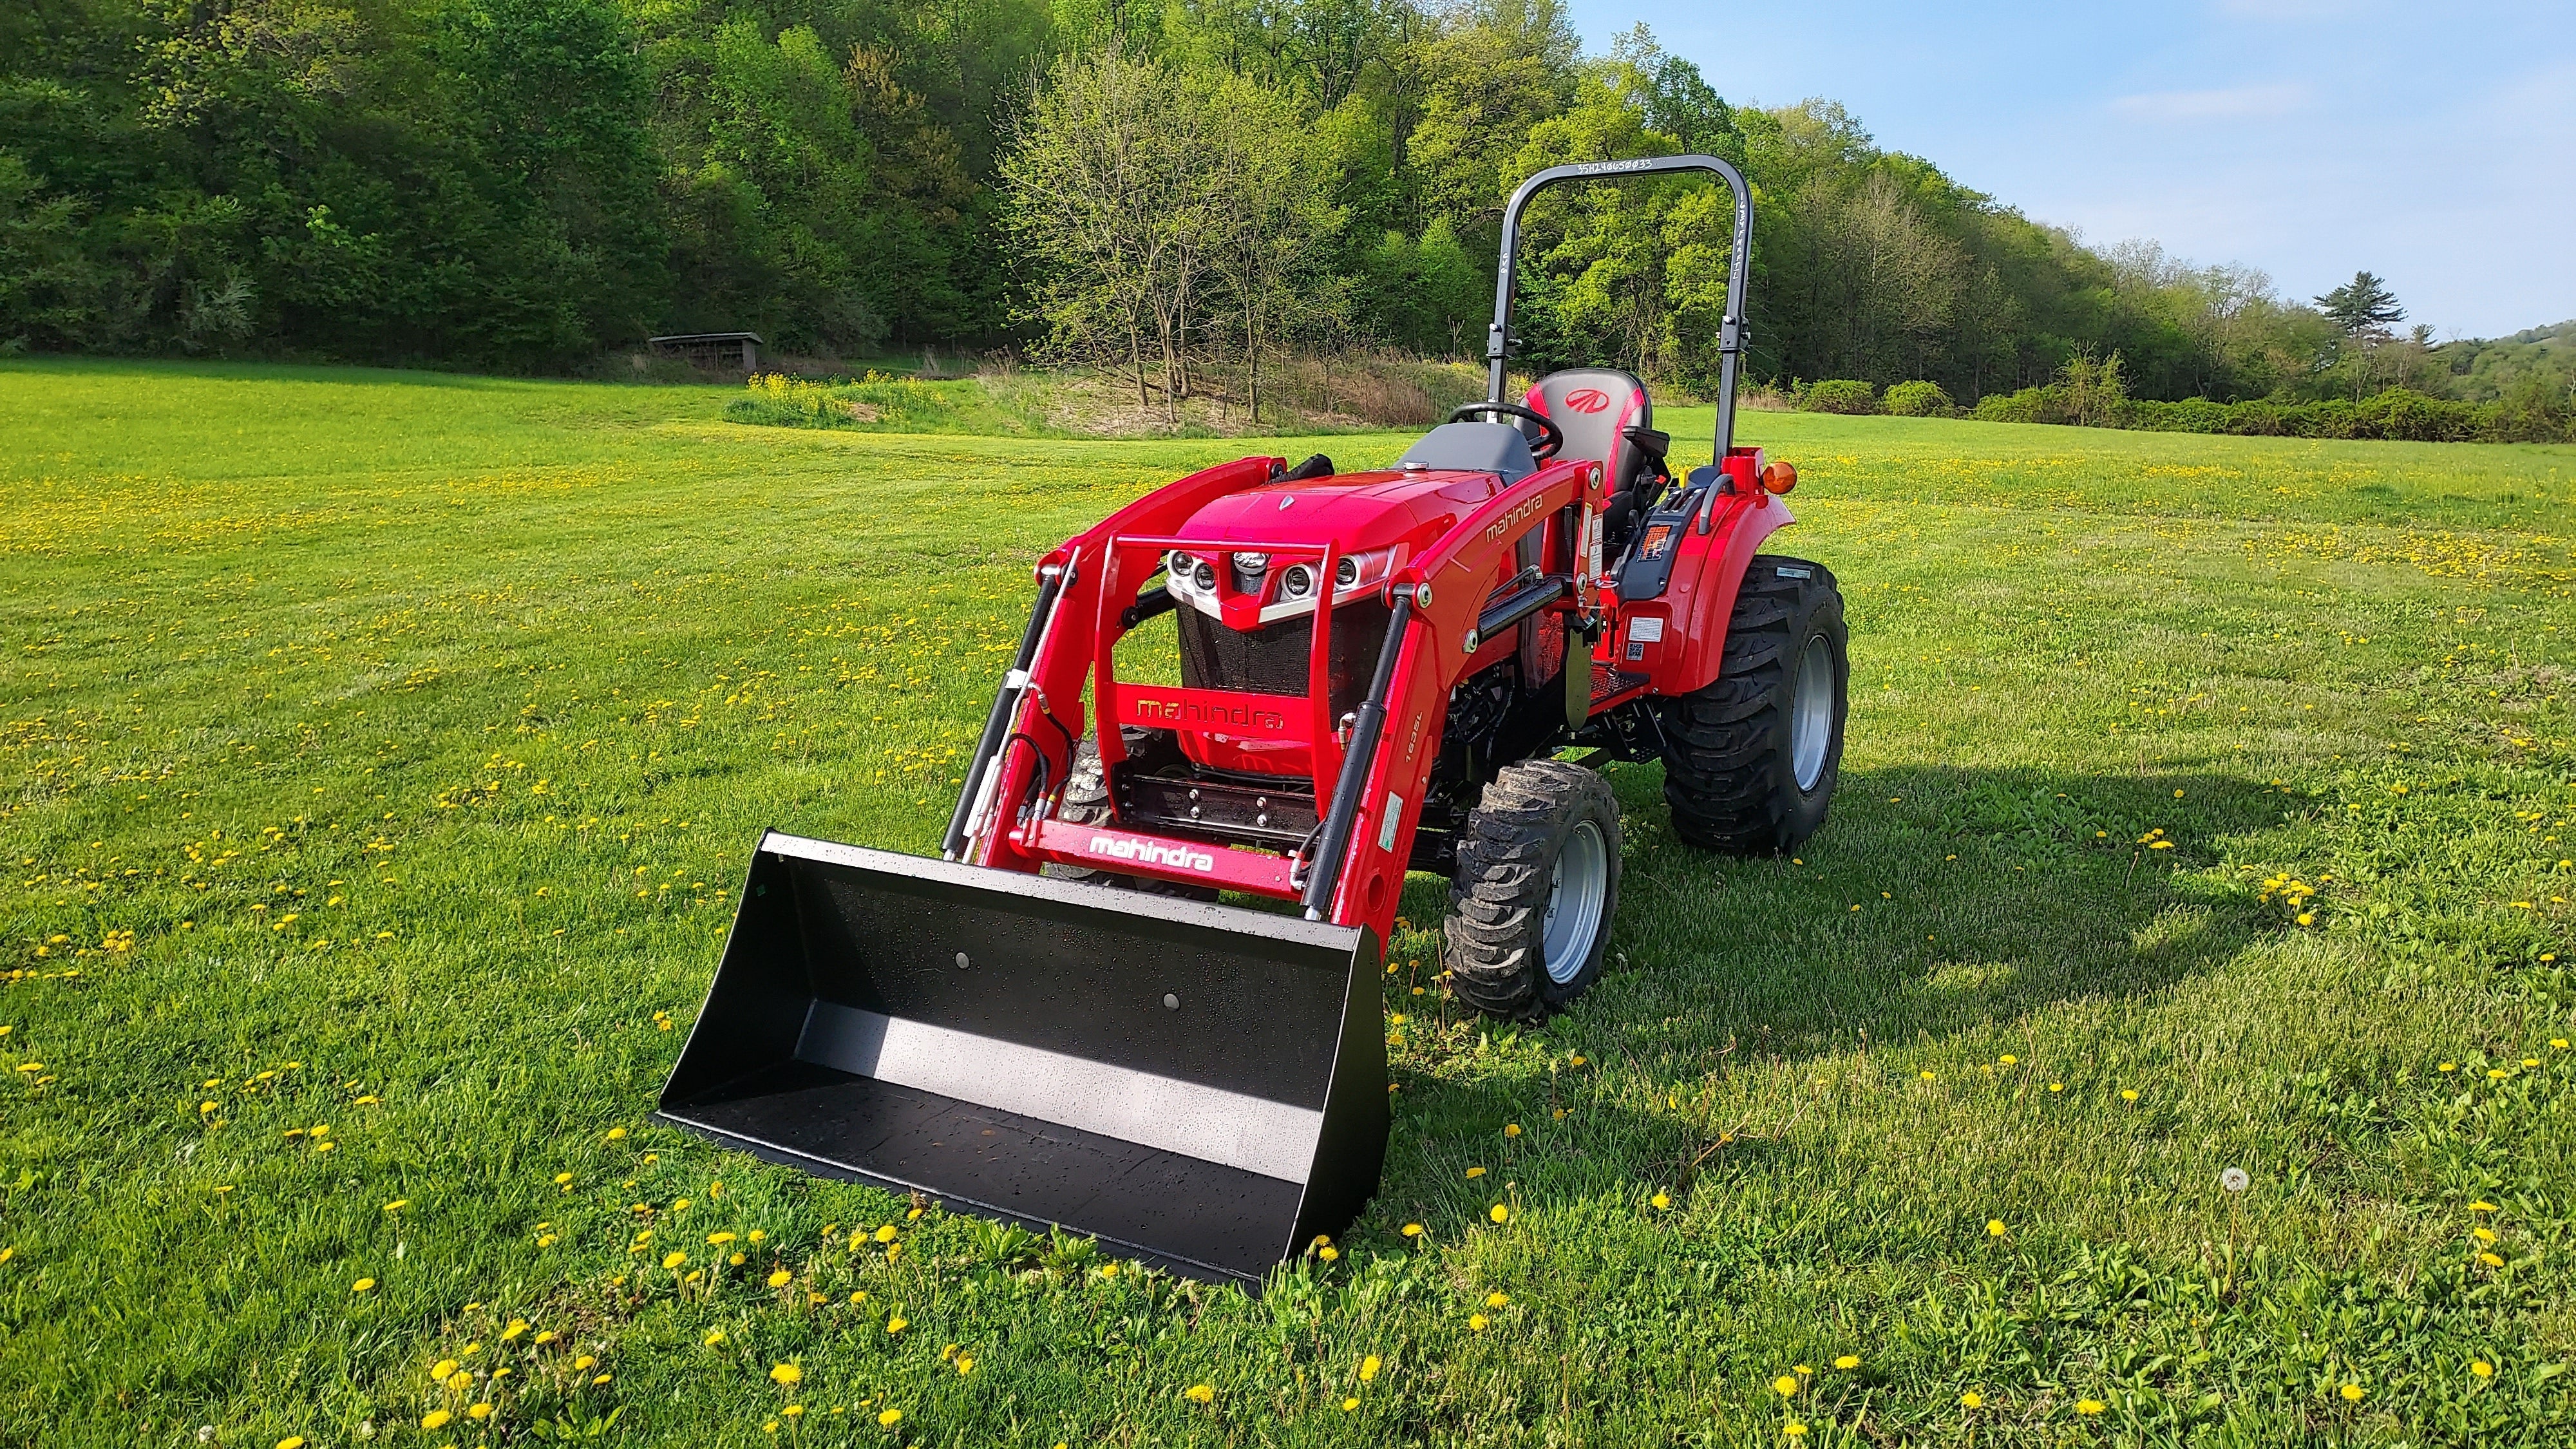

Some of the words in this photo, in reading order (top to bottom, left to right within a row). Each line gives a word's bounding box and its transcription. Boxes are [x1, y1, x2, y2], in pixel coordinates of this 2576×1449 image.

[1486, 494, 1543, 543] mahindra
[1137, 699, 1284, 729] mahindra
[1406, 712, 1423, 763] 1635L
[1089, 837, 1213, 872] mahindra
